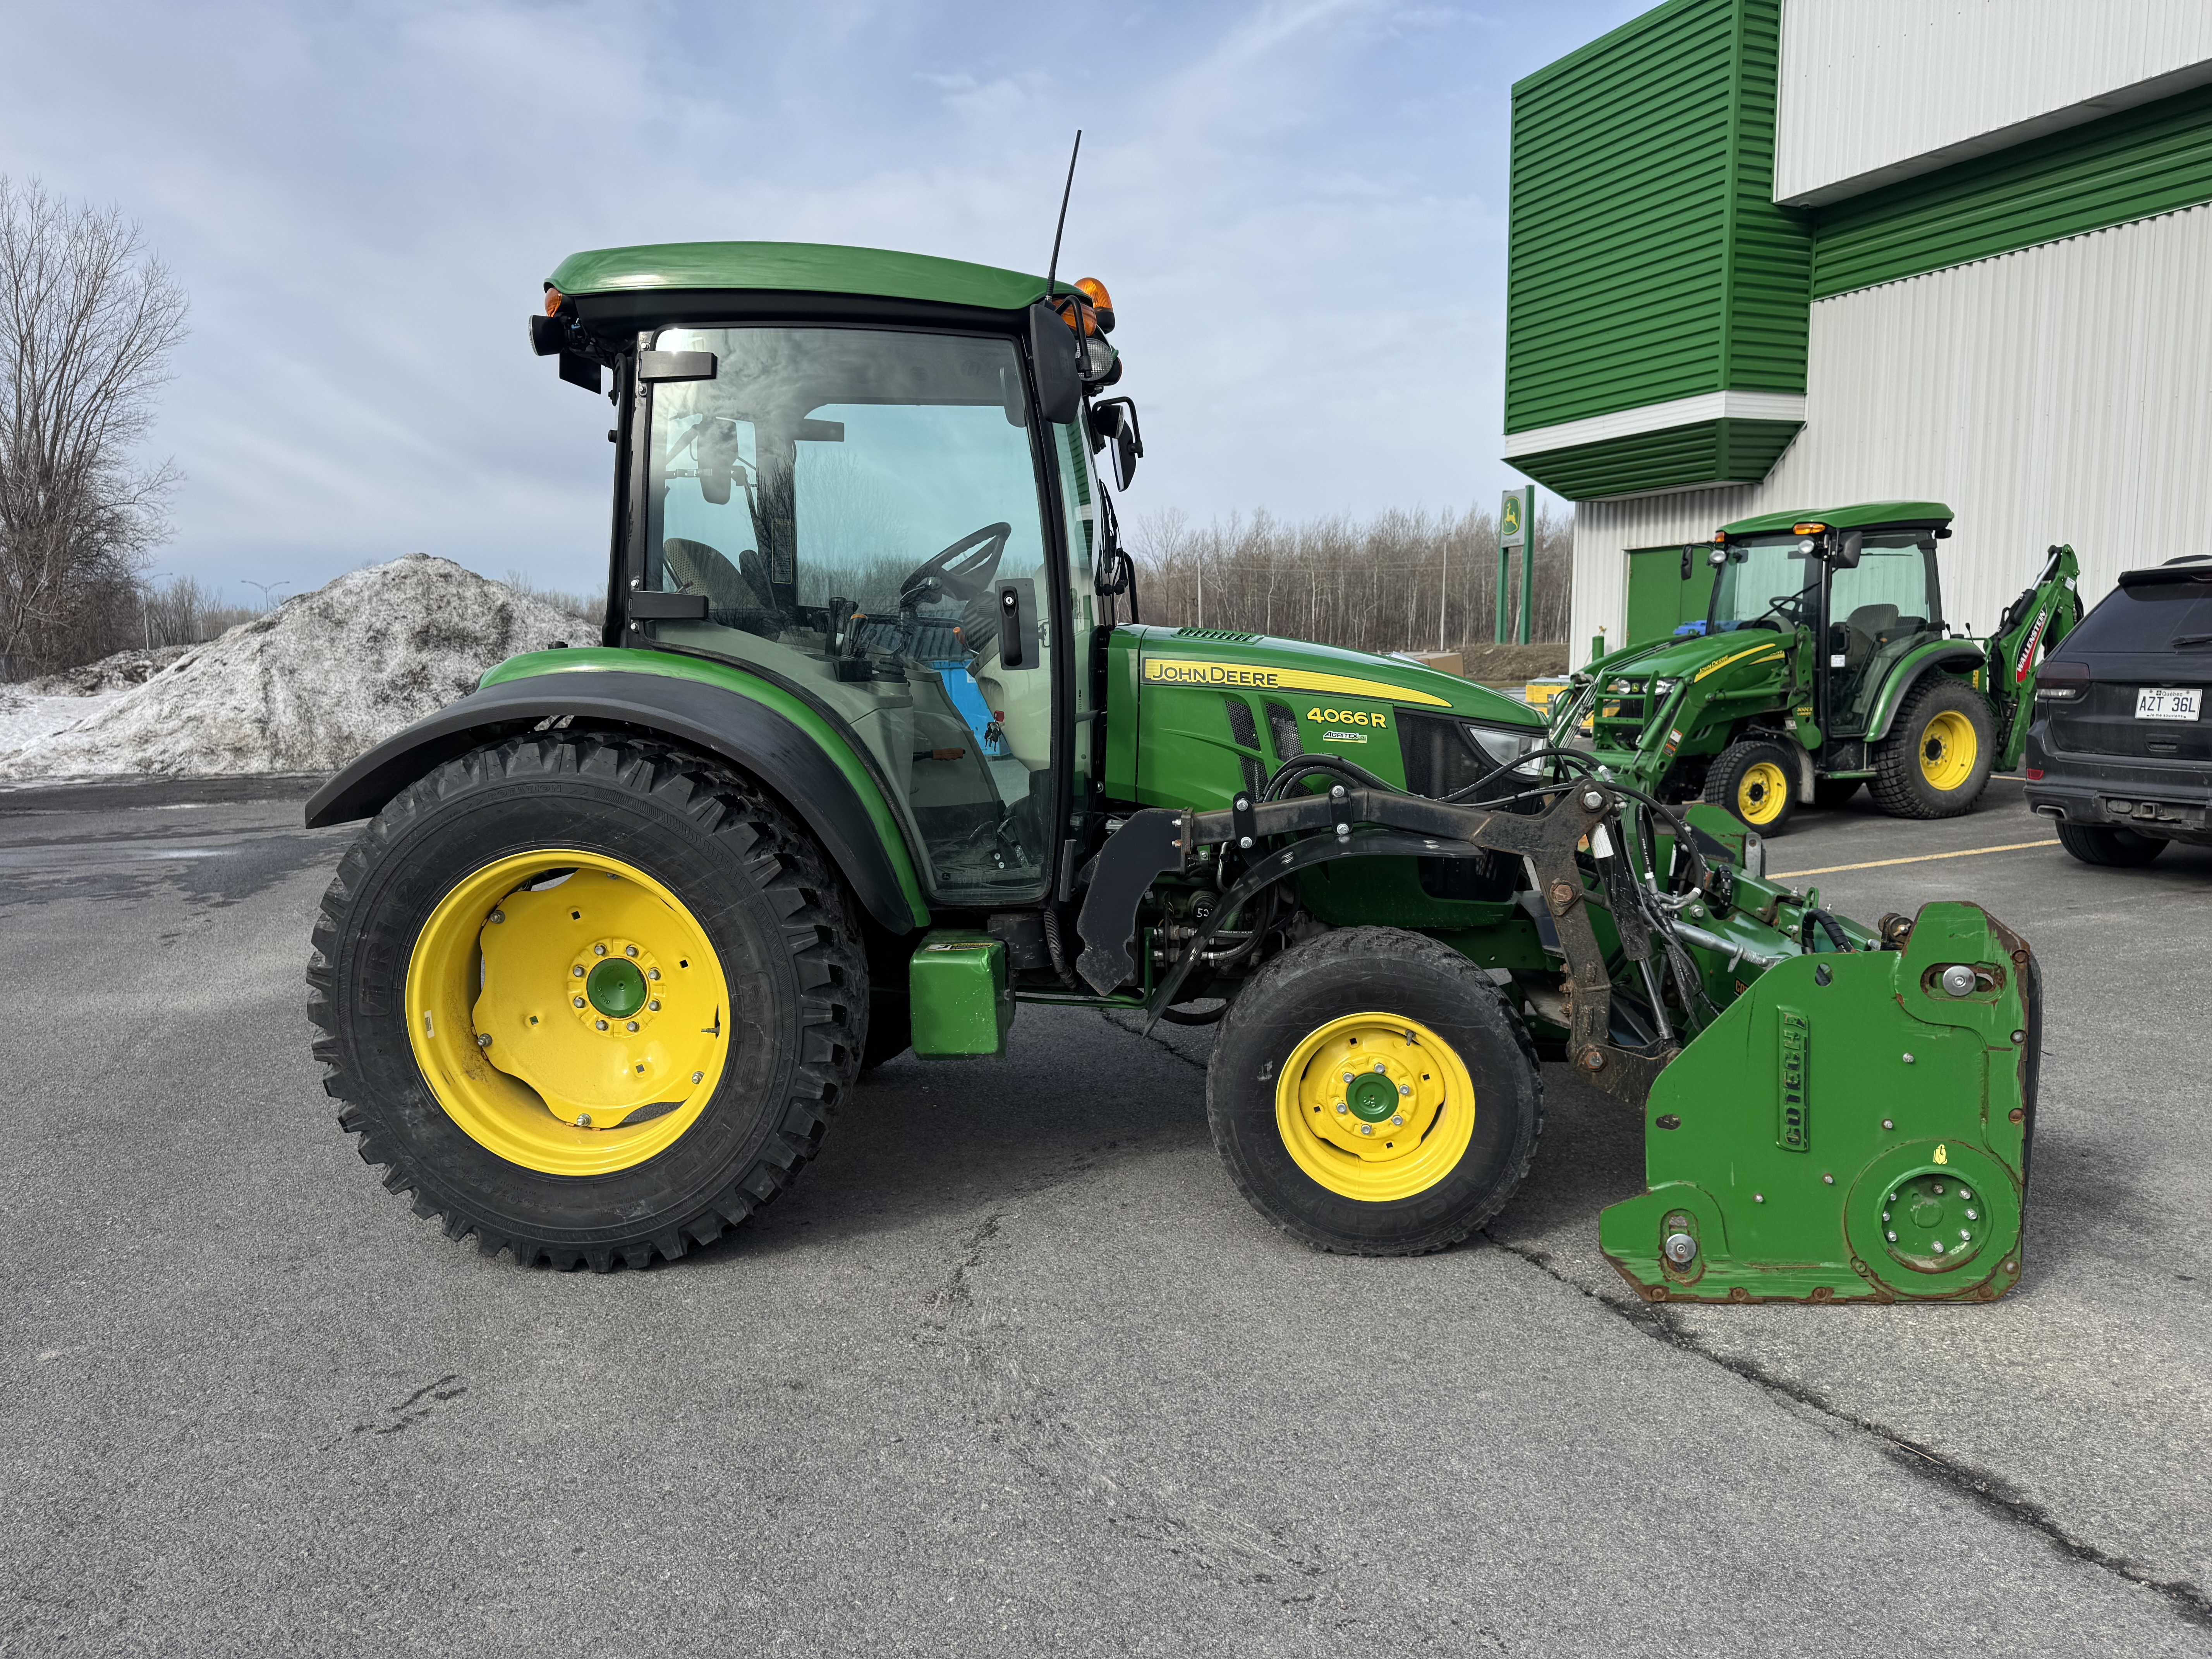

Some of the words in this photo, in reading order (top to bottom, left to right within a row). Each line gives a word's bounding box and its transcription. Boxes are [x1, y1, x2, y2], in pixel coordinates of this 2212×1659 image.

[2017, 610, 2046, 673] WALLENSTEIN
[1152, 664, 1206, 681] JOHN
[1210, 666, 1278, 686] DEERE
[1698, 664, 1712, 675] JOHN
[1712, 654, 1729, 667] DEERE
[2139, 696, 2164, 711] AZT
[2172, 697, 2196, 713] 36L
[1324, 731, 1358, 739] AGRITEX
[486, 784, 561, 801] ROTATION
[361, 918, 400, 1003] TRI
[390, 871, 426, 909] 2
[1736, 980, 1748, 994] CO
[1783, 1029, 1801, 1145] COTECH
